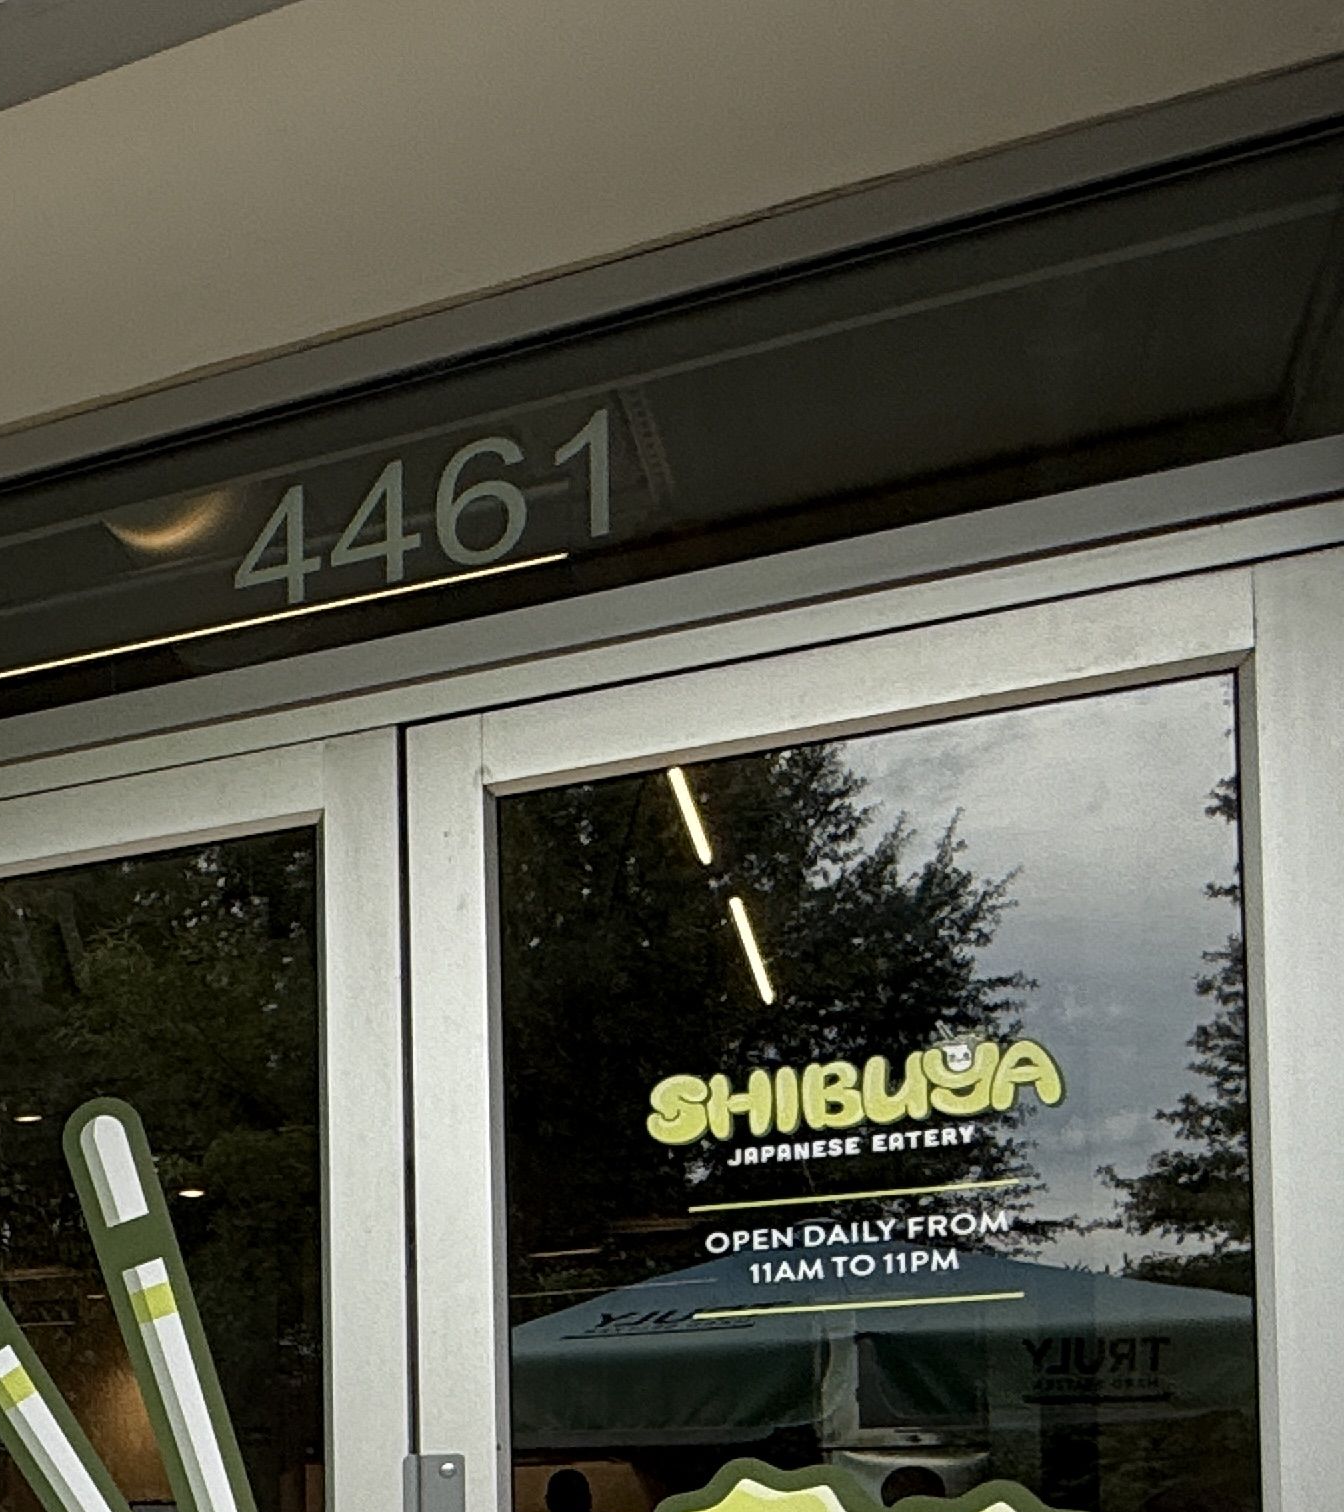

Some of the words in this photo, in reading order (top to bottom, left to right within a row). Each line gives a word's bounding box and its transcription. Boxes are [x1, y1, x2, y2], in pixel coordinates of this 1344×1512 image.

[233, 407, 611, 604] 4461
[646, 1038, 1067, 1146] SHIBUYA
[727, 1136, 862, 1167] JAPANESE
[872, 1124, 976, 1152] EATERY
[704, 1226, 795, 1254] OPEN
[803, 1217, 897, 1248] DAILY
[907, 1210, 1010, 1240] FROM
[749, 1257, 826, 1284] 11AM
[831, 1252, 877, 1278] TO
[882, 1248, 961, 1275] 11PM
